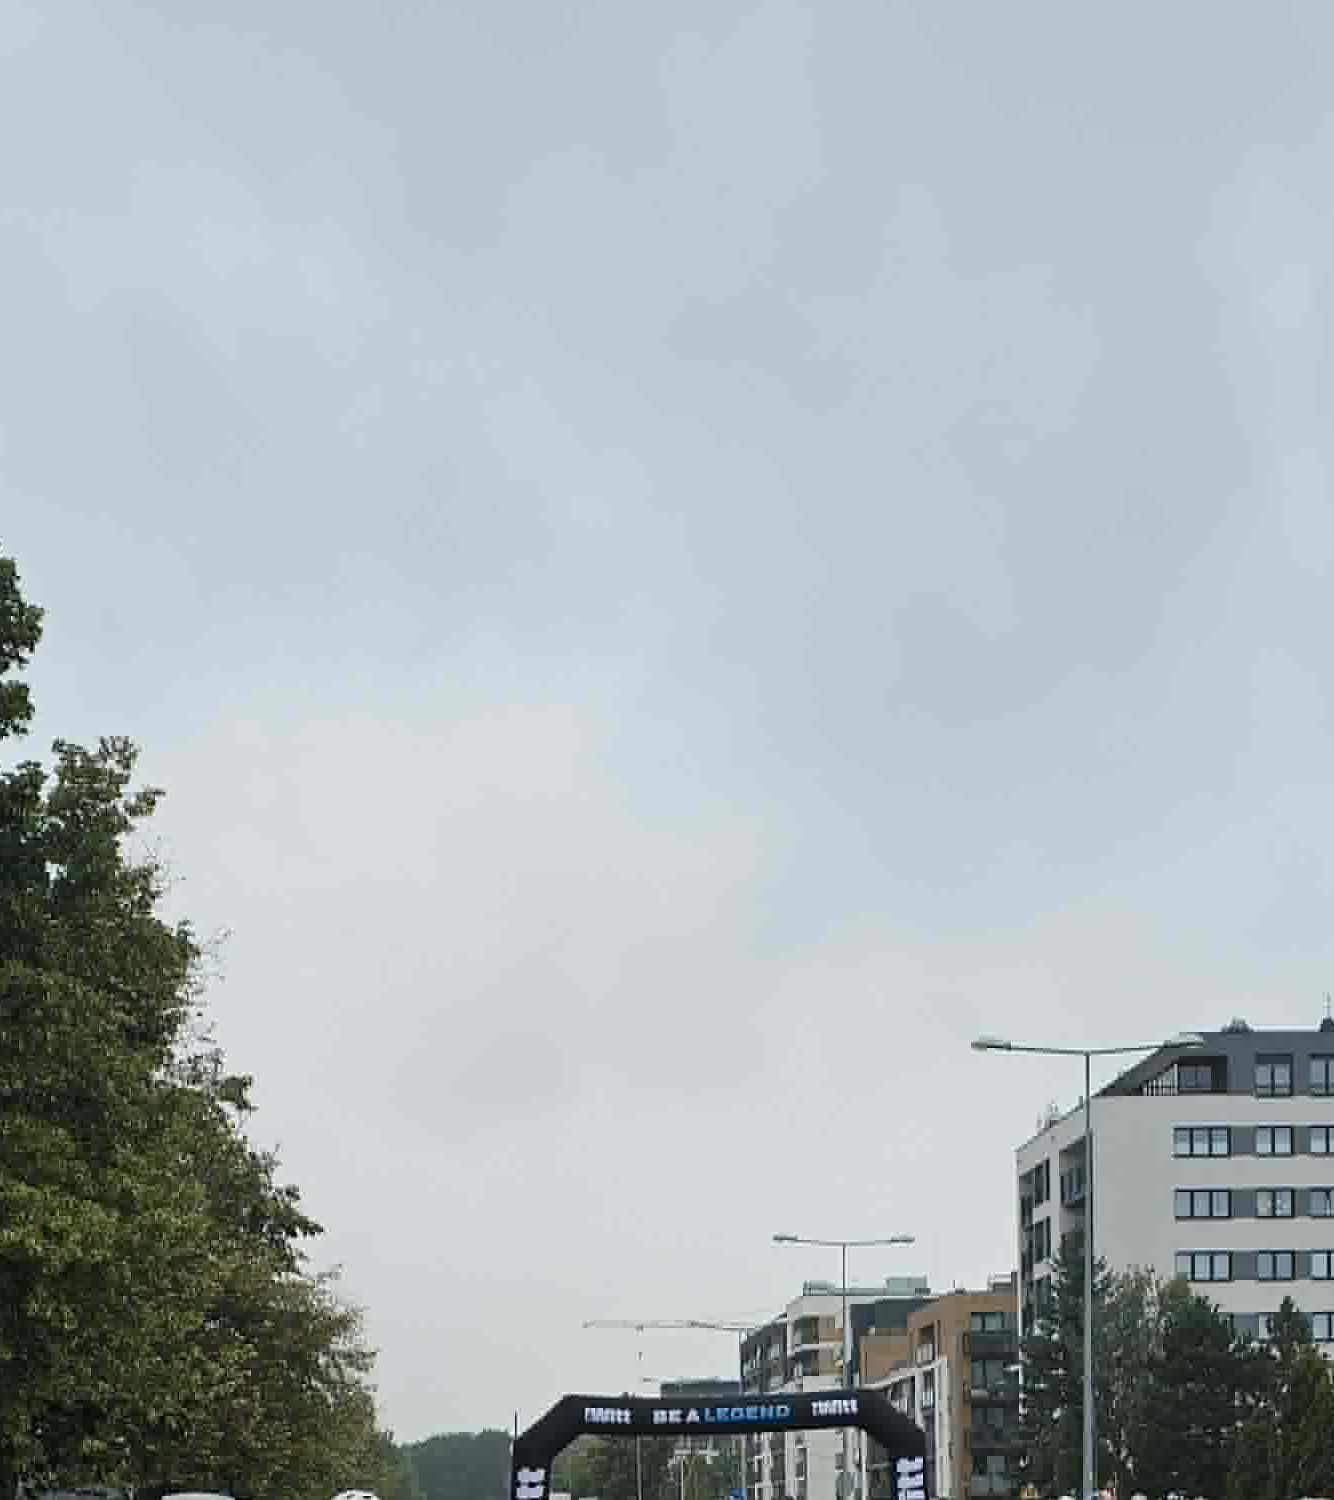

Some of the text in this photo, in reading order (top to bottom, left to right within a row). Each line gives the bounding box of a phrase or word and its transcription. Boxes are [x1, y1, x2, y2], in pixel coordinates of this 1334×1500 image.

[652, 1408, 683, 1424] BE
[685, 1407, 701, 1424] A
[703, 1405, 790, 1423] LEGEND
